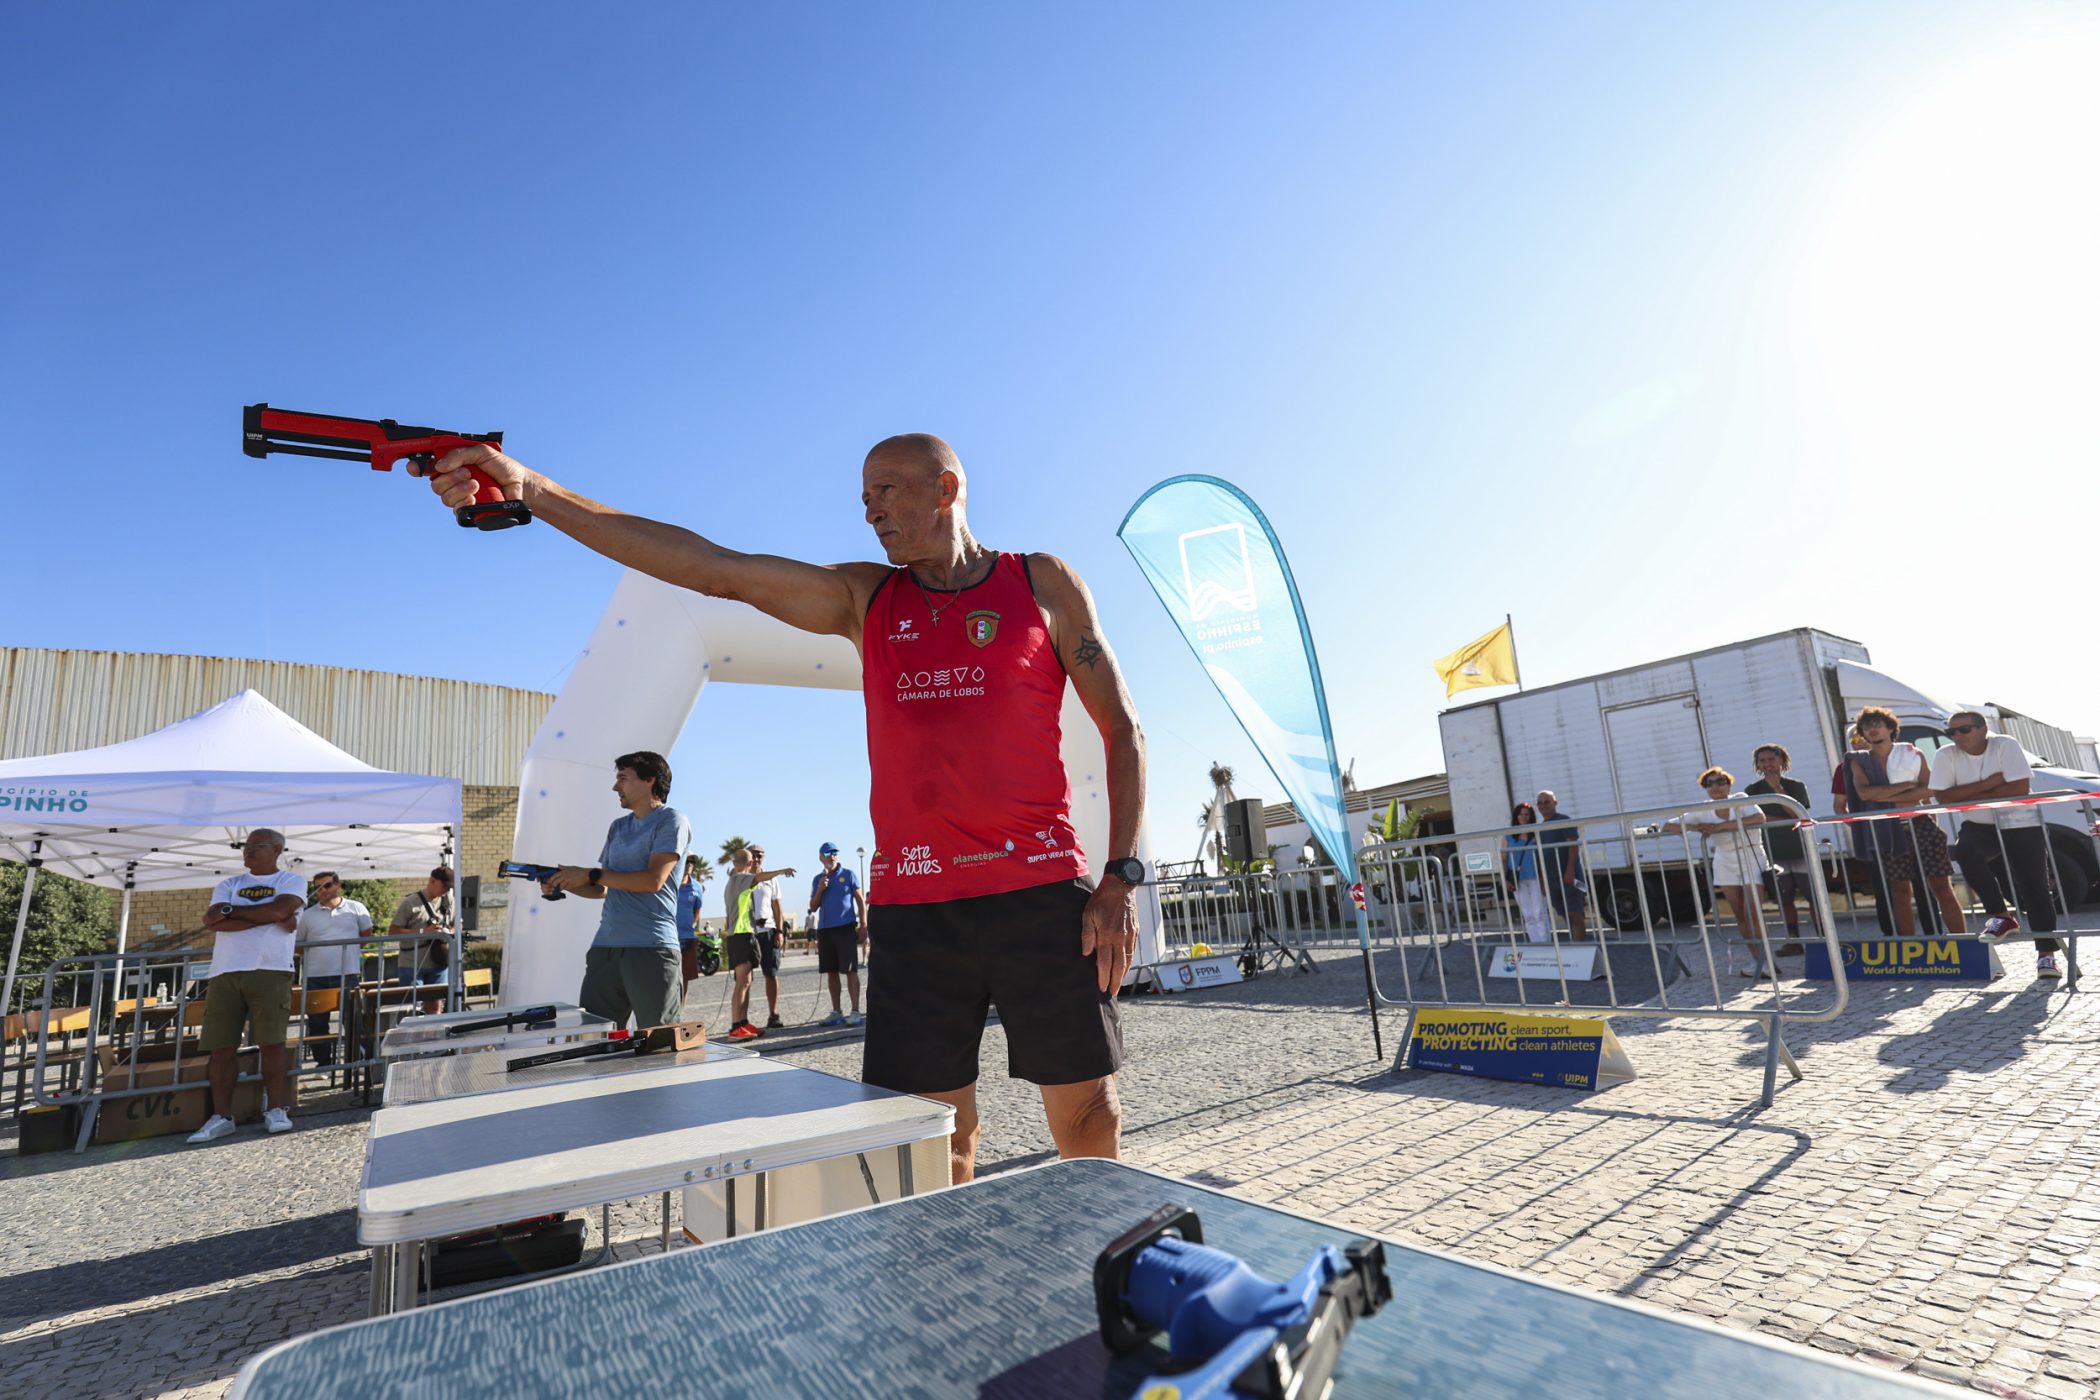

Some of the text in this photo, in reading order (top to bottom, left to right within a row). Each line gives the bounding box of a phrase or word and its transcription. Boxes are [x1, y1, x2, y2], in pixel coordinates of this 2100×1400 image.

[897, 687, 985, 702] CÂMARA DE LOBOS
[901, 844, 932, 861] Sete
[953, 850, 1009, 865] planetépoca
[1027, 853, 1047, 864] SUPER
[1048, 850, 1064, 860] VERA
[896, 859, 943, 877] Mares
[1861, 940, 1960, 965] UIPM
[1195, 965, 1221, 977] FPPM
[1862, 966, 1961, 975] World Pentathlon
[1418, 1022, 1573, 1040] PROMOTING clean sport,
[1422, 1035, 1596, 1052] PROTECTING clean athletes
[1564, 1073, 1589, 1084] UIPM
